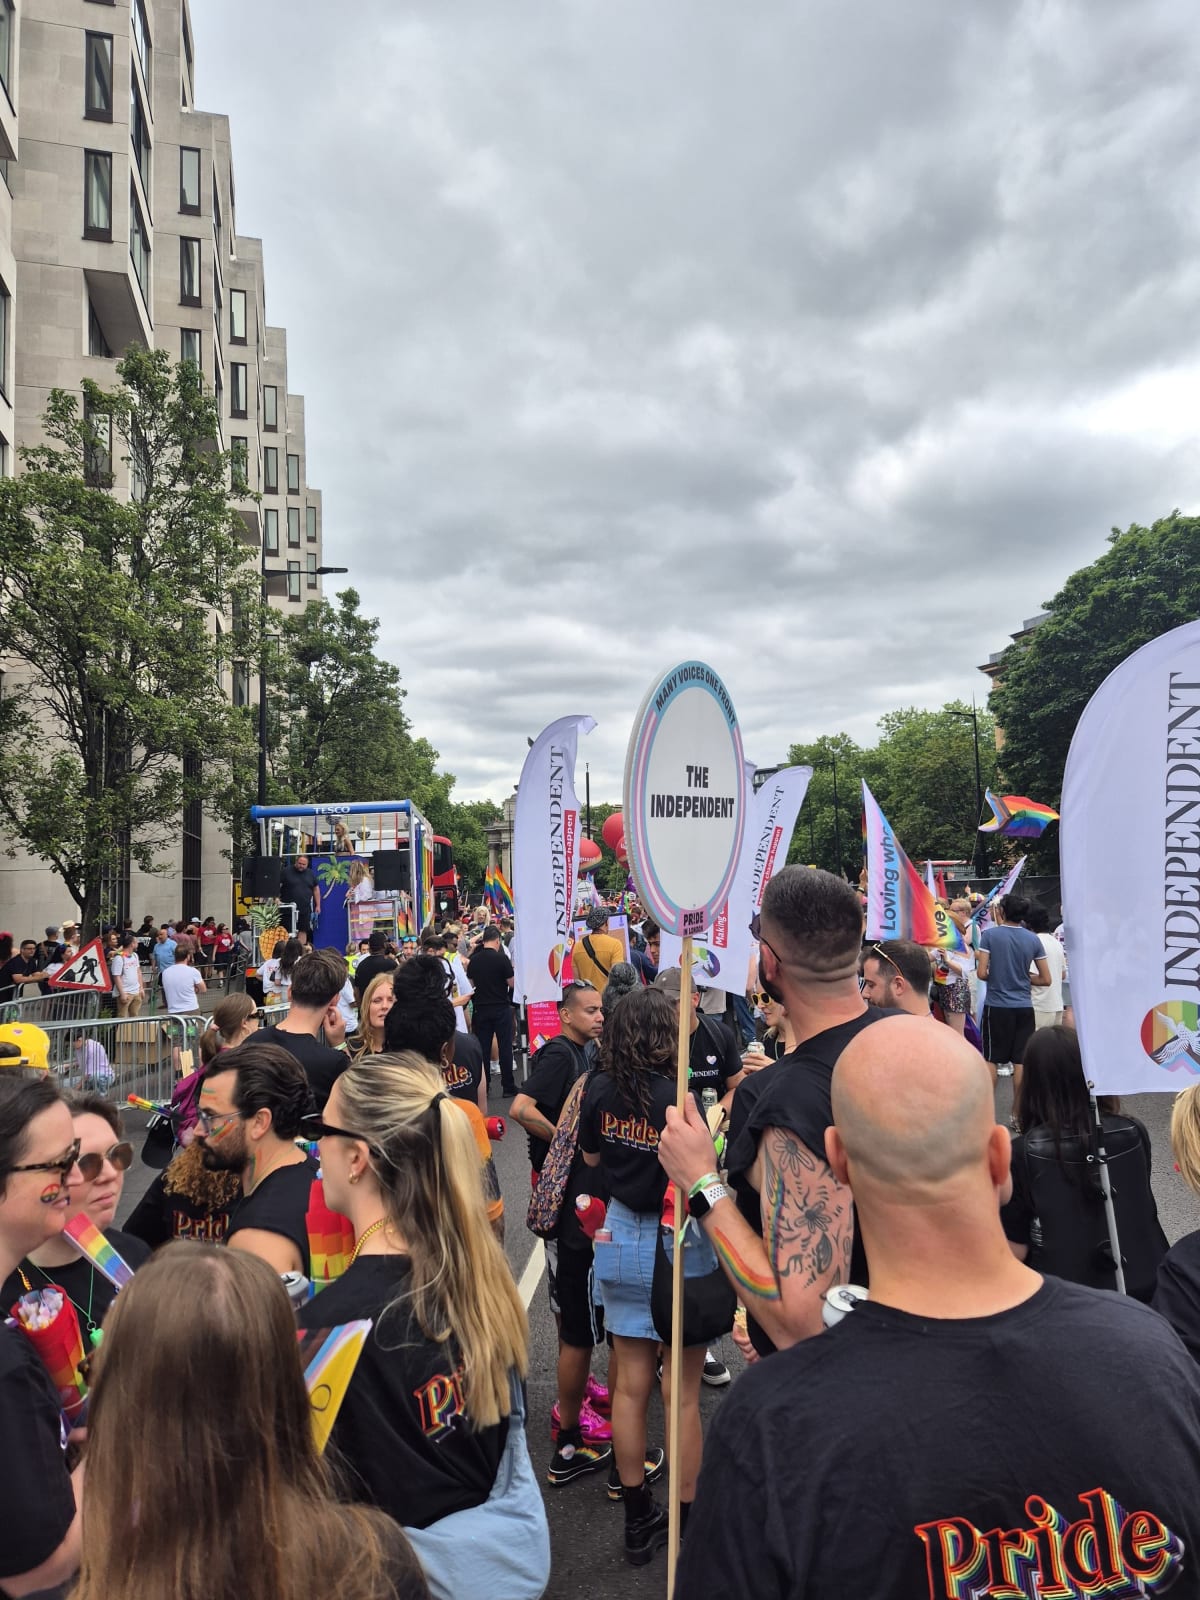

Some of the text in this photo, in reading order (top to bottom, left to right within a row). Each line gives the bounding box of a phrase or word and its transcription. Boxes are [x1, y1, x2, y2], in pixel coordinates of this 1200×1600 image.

[655, 666, 736, 725] MANY VOICES ONE FRONT
[686, 764, 709, 788] THE
[313, 806, 351, 815] TESCO
[650, 794, 735, 818] INDEPENDENT
[549, 745, 566, 937] INDEPENDENT
[566, 814, 574, 854] happen
[1164, 671, 1200, 991] INDEPENDENT
[880, 869, 899, 931] Loving
[688, 925, 704, 935] LONDON
[715, 916, 727, 945] Making
[934, 909, 948, 937] we
[691, 1069, 720, 1078] PENDENT
[600, 1110, 660, 1152] Pride
[171, 1209, 230, 1242] Prid
[914, 1487, 1186, 1600] Pride
